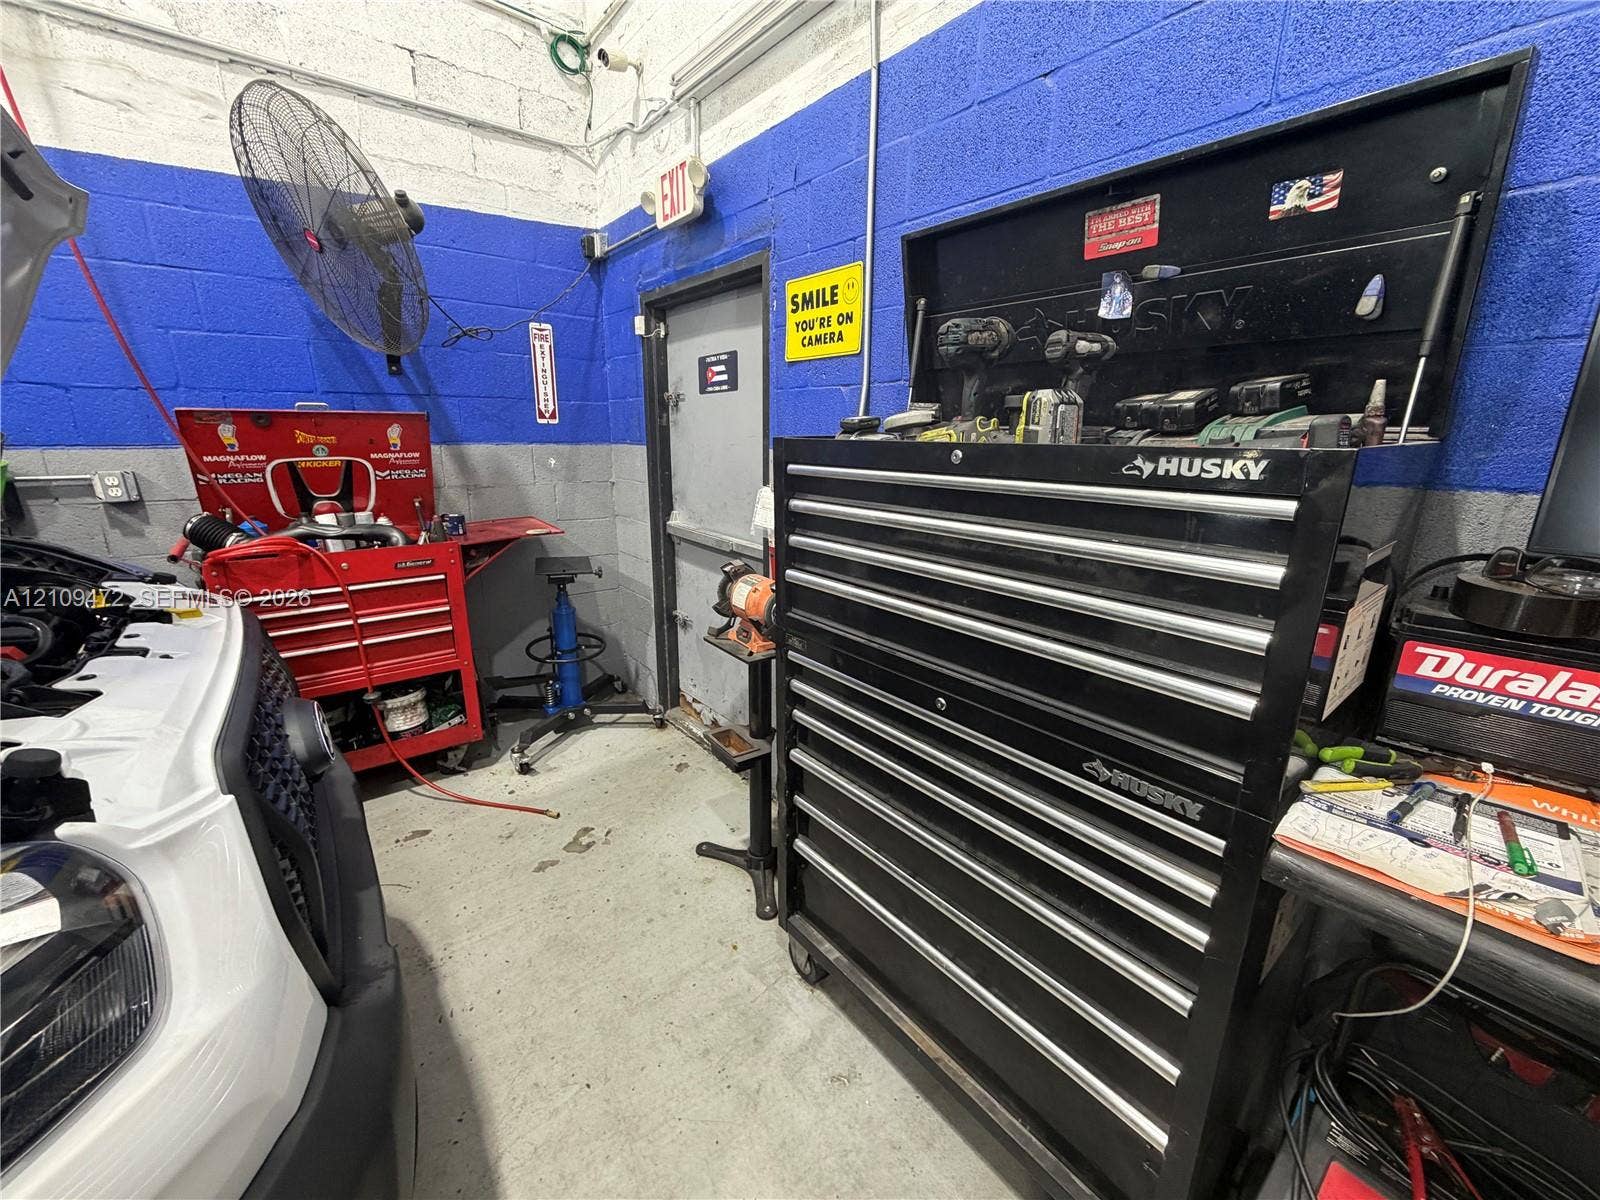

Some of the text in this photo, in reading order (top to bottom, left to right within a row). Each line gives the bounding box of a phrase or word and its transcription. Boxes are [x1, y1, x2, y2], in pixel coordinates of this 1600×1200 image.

[661, 160, 686, 222] EXIT
[1090, 211, 1152, 234] THE BEST
[1102, 209, 1129, 222] ARMED
[1131, 204, 1151, 215] WITH
[1098, 237, 1142, 252] Snap-on
[790, 284, 839, 314] SMILE
[795, 311, 853, 333] YOU'RE ON
[533, 333, 550, 343] FIRE
[801, 330, 844, 348] CAMERA
[539, 343, 550, 415] EXTINGUISHER
[202, 454, 267, 462] MAGNAFLOW
[306, 460, 341, 468] KICKER
[1156, 456, 1271, 481] HUSKY
[1414, 646, 1600, 709] Durala
[1431, 684, 1525, 711] PROVEN
[1110, 768, 1205, 821] HUSKY
